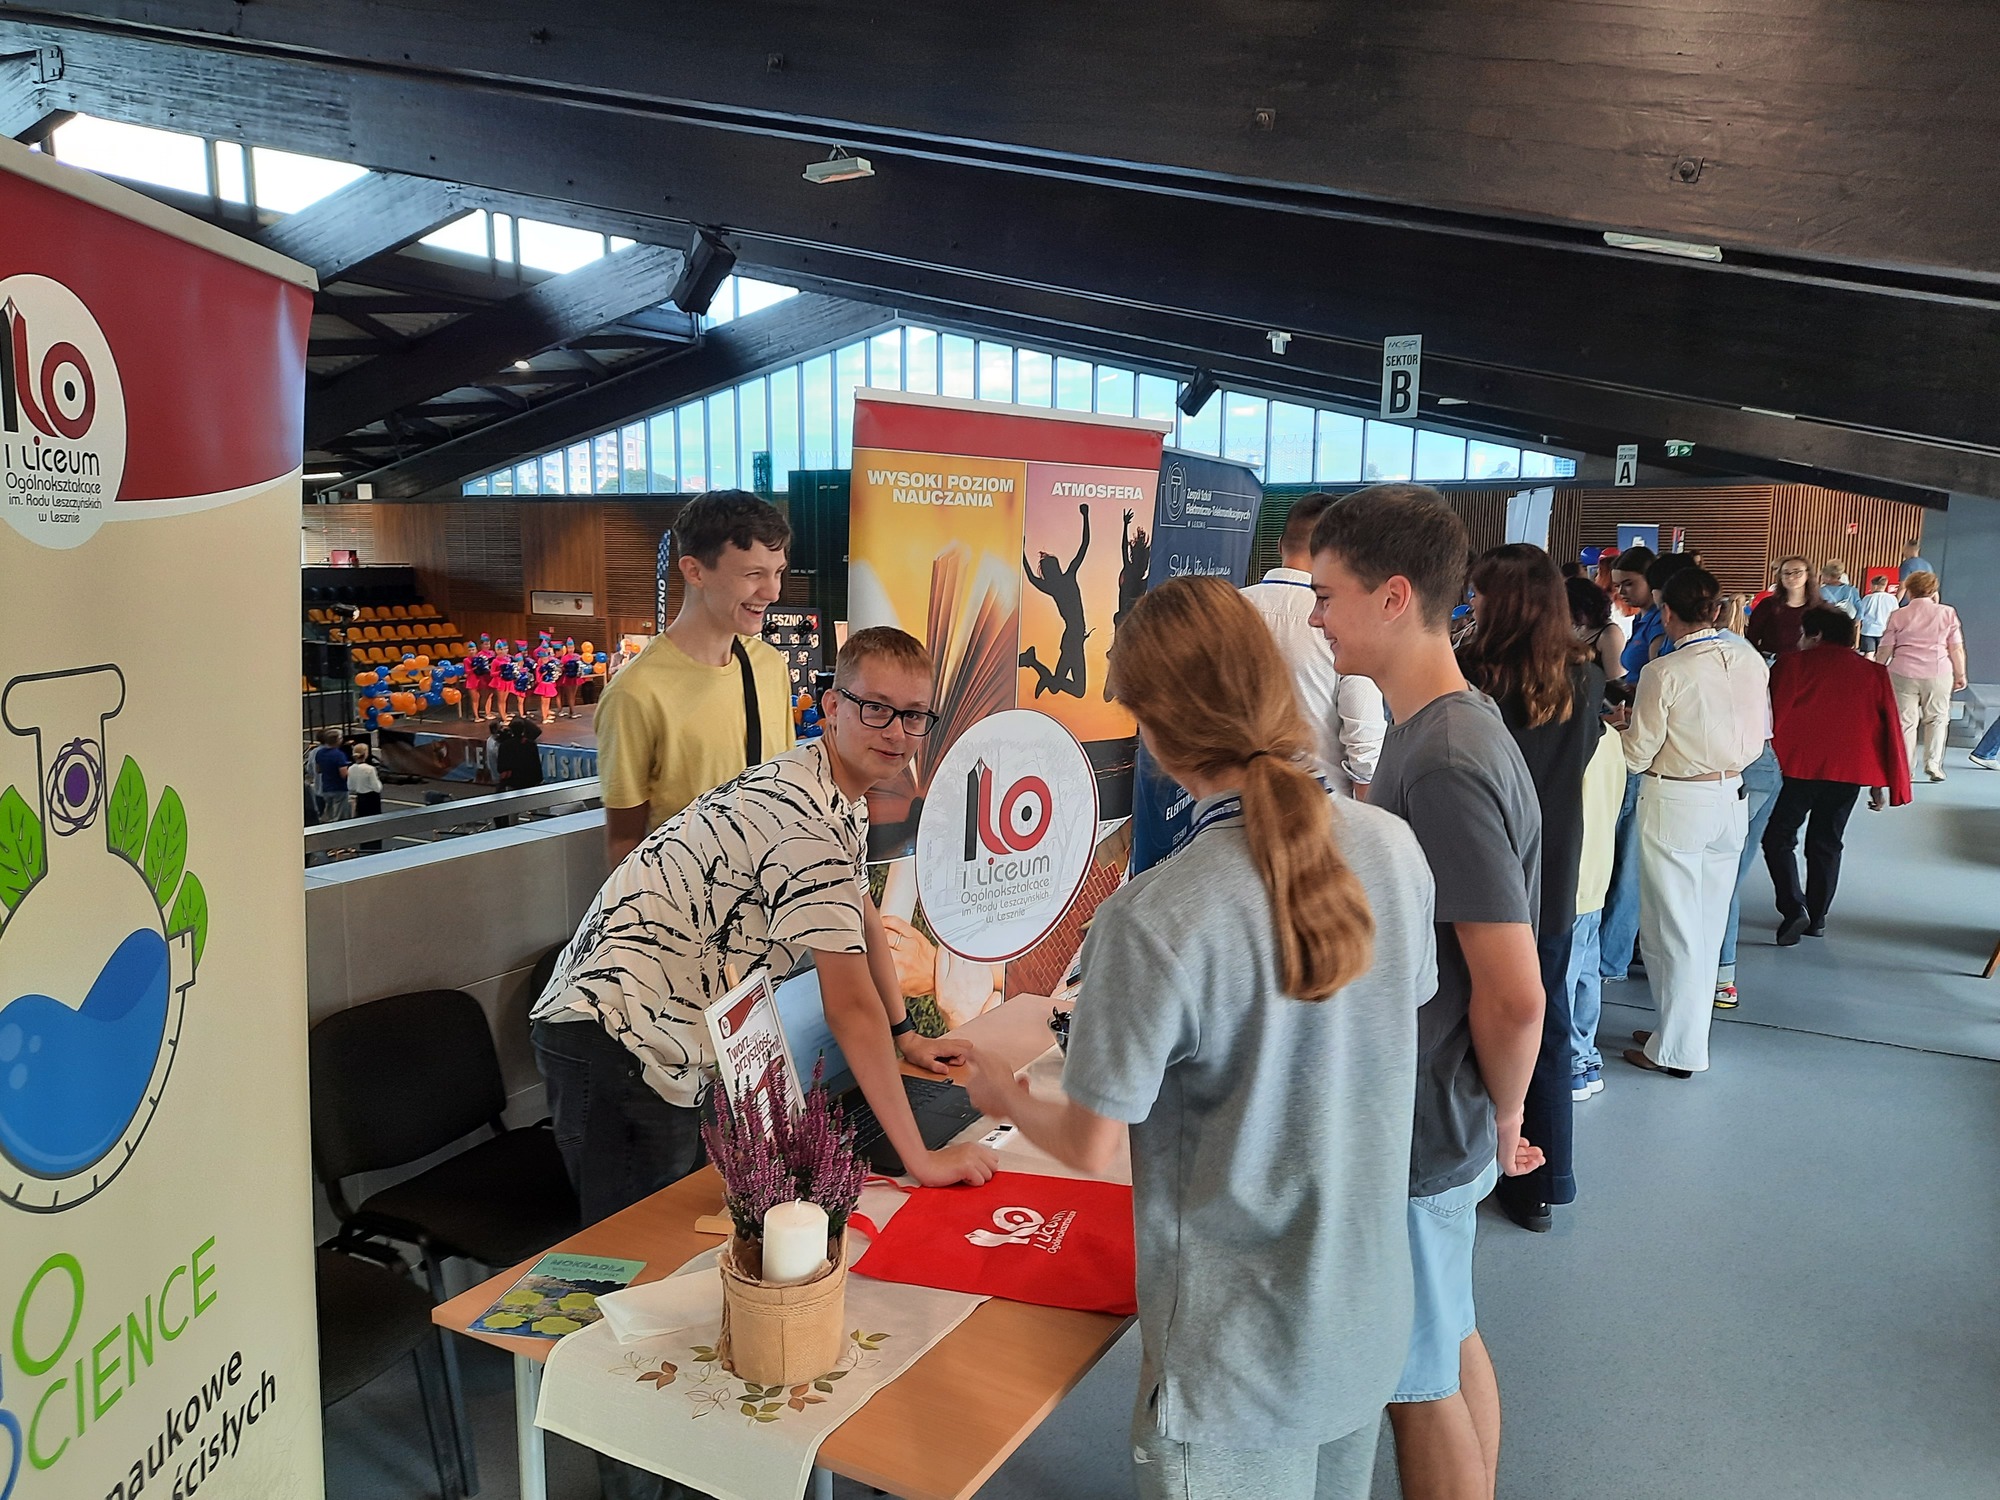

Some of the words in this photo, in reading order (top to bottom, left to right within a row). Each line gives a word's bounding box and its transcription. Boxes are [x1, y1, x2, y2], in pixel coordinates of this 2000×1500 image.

[1385, 354, 1418, 367] SEKTOR
[1389, 370, 1411, 414] B
[5, 443, 11, 469] I
[21, 435, 100, 476] Liceum
[5, 472, 102, 496] Ogólnokształcące
[867, 470, 943, 489] WYSOKI
[949, 475, 1015, 493] POZIOM
[1619, 462, 1631, 484] A
[26, 493, 50, 507] Rodu
[892, 488, 995, 508] NAUCZANIA
[1051, 482, 1145, 500] ATMOSFERA
[50, 510, 80, 523] Lesznie
[657, 579, 667, 634] ESZNO
[962, 870, 967, 890] I
[976, 855, 1050, 886] Liceum
[960, 878, 1050, 907] Ogólnokształcące
[976, 901, 998, 914] Rodu
[997, 908, 1026, 921] Lesznie
